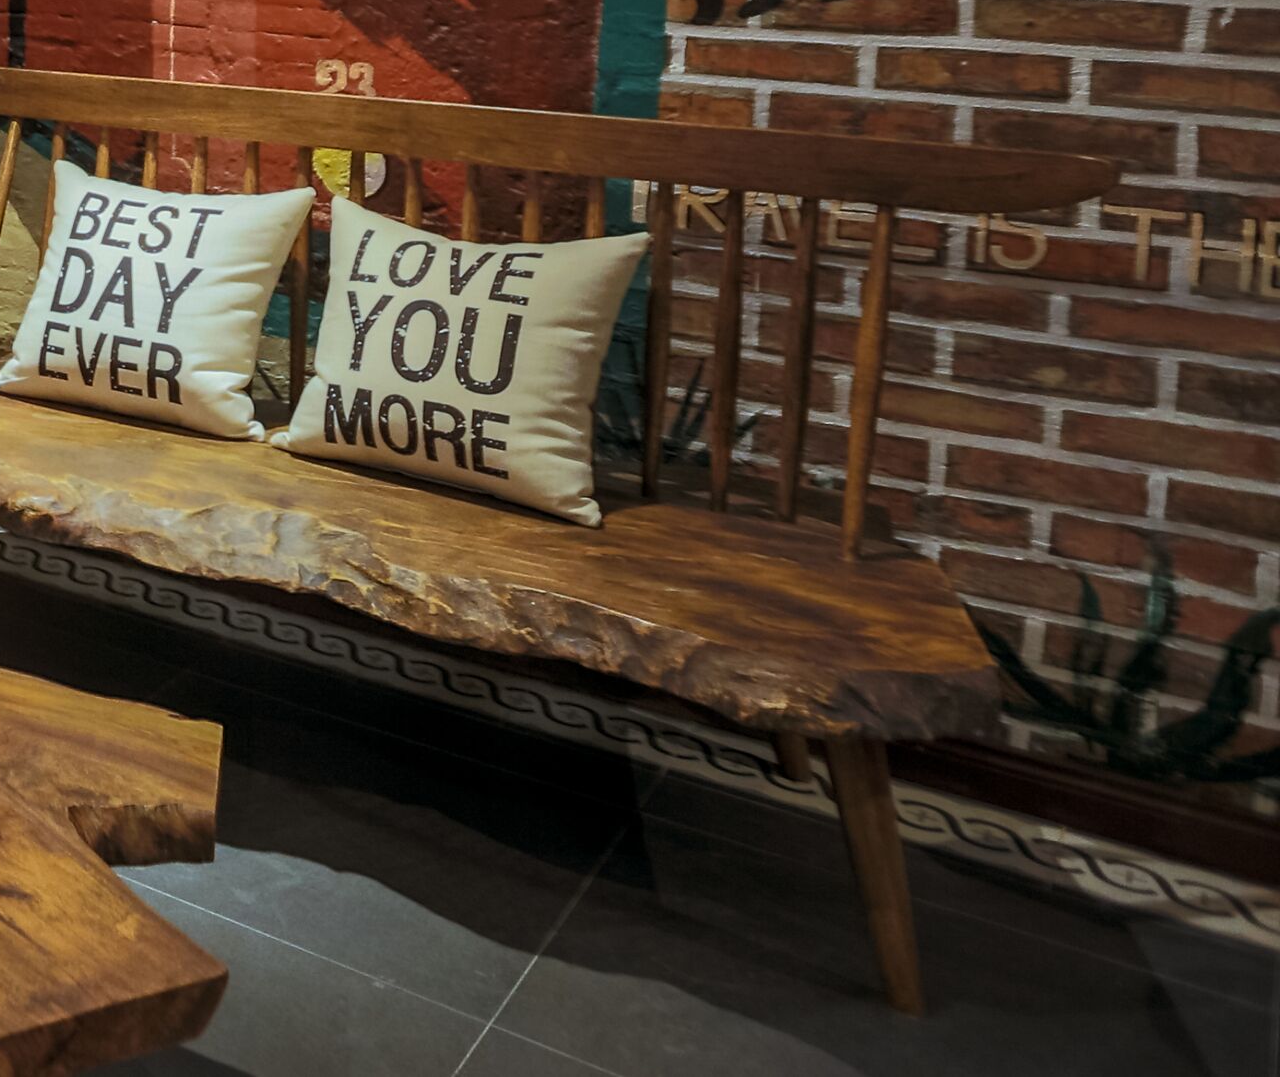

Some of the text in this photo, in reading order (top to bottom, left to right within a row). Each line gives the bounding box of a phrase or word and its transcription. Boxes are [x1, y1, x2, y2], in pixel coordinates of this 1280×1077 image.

[69, 191, 224, 259] BEST
[348, 228, 545, 307] LOVE
[975, 212, 1048, 270] IS
[49, 246, 203, 334] DAY
[38, 321, 183, 406] EVER
[346, 290, 524, 396] YOU
[323, 383, 511, 480] MORE
